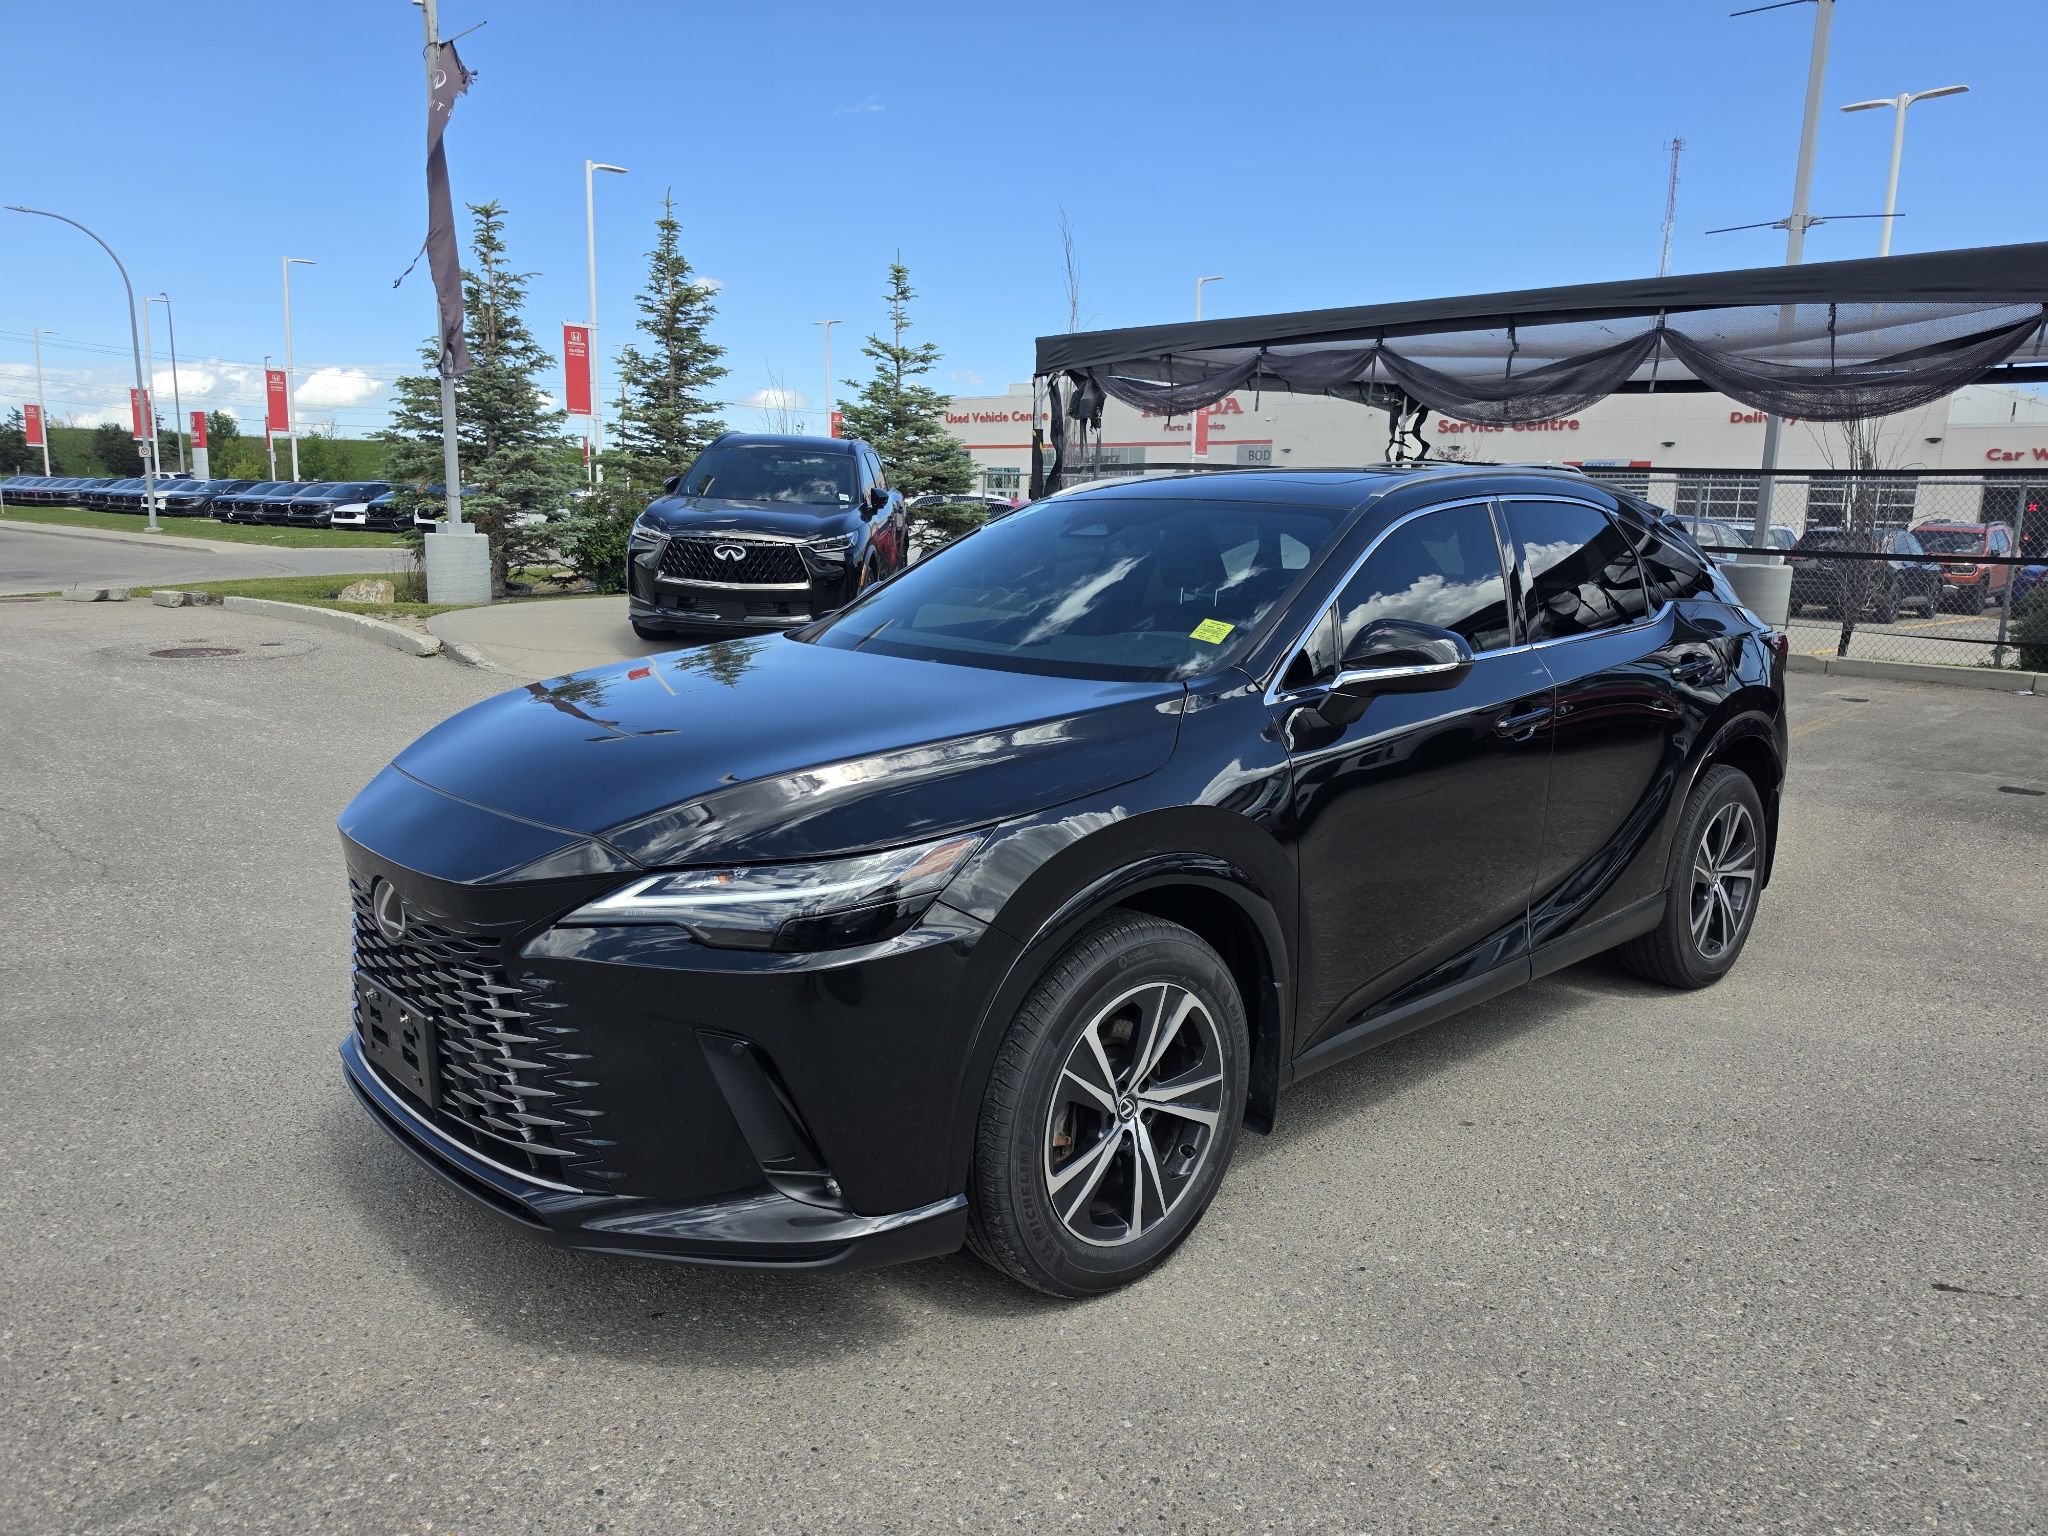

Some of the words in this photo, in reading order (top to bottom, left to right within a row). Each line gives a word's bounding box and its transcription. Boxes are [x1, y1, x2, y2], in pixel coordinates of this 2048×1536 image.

[945, 412, 970, 424] Used
[972, 411, 1009, 423] Vehicle
[1011, 410, 1049, 422] Cene
[1437, 419, 1505, 434] Service
[1511, 418, 1580, 432] Centre
[1985, 448, 2025, 461] Car
[1017, 1146, 1045, 1241] MICHELIN
